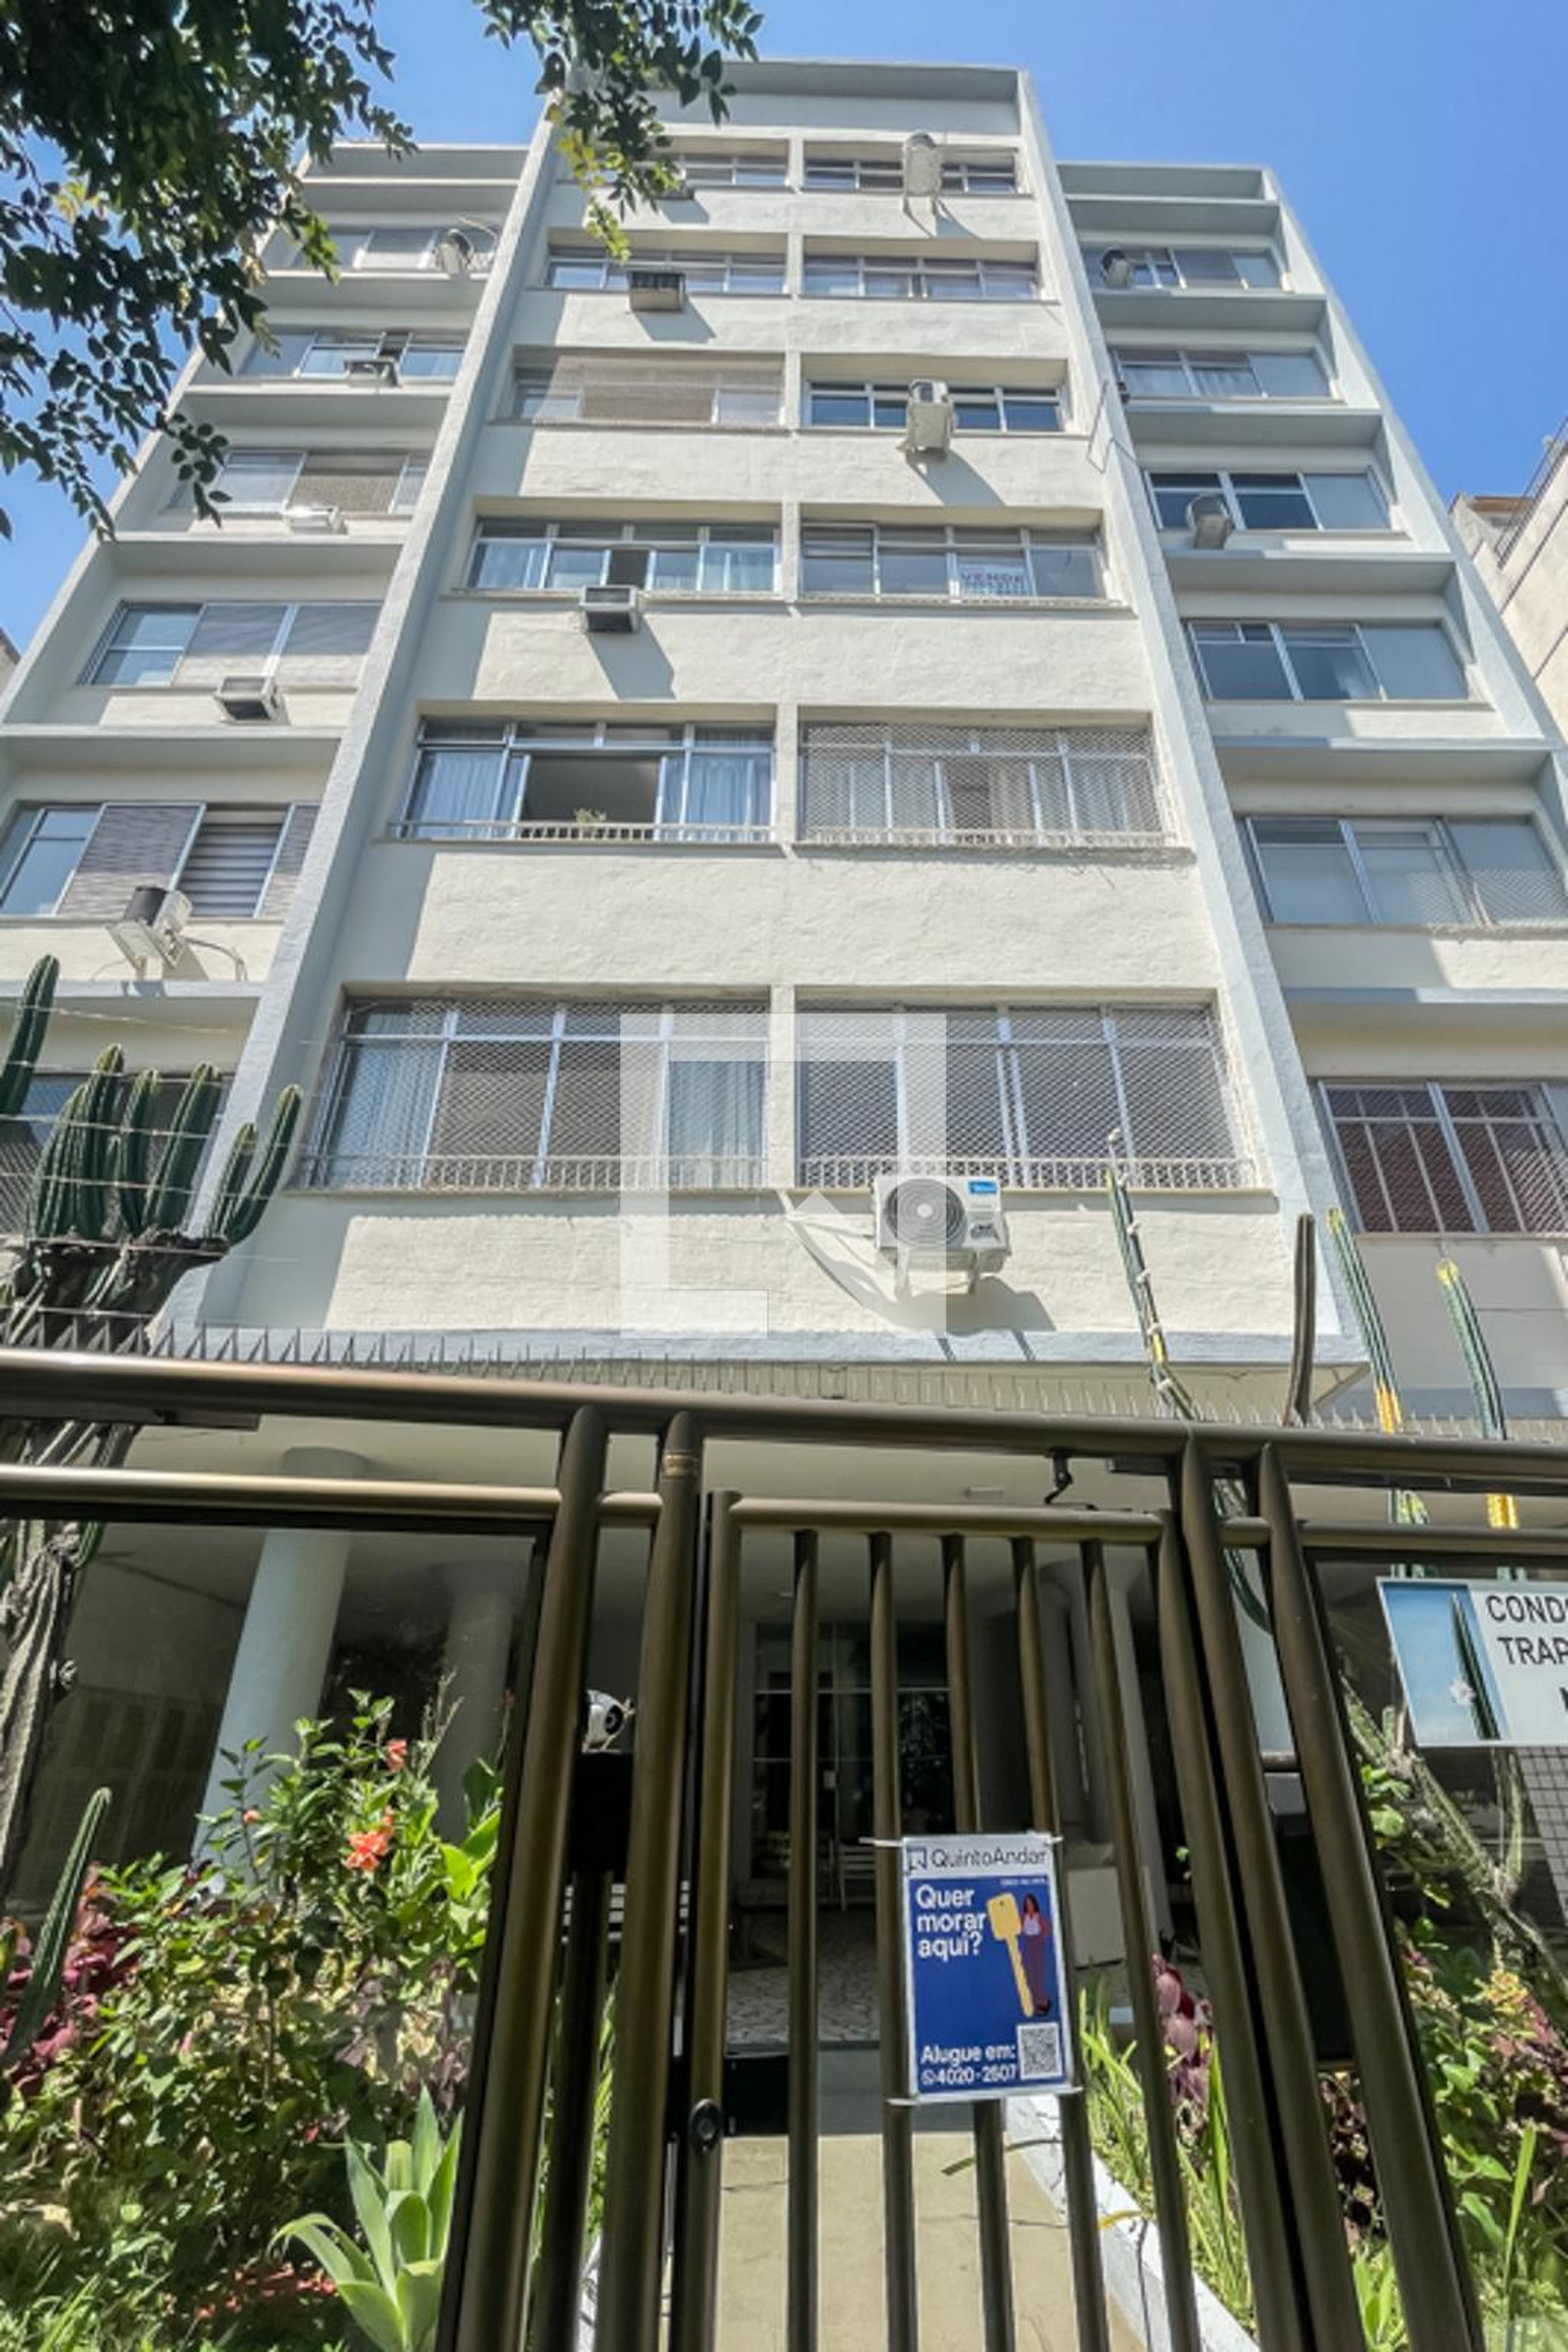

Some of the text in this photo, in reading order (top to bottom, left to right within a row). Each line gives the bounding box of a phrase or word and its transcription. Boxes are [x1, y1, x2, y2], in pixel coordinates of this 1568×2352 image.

[1486, 1595, 1568, 1624] COND
[931, 1846, 1047, 1868] QuintoAndar
[916, 1884, 975, 1910] Quer
[917, 1913, 987, 1933] morar
[918, 1931, 983, 1962] aqui?
[920, 2043, 1016, 2067] Alugue em:
